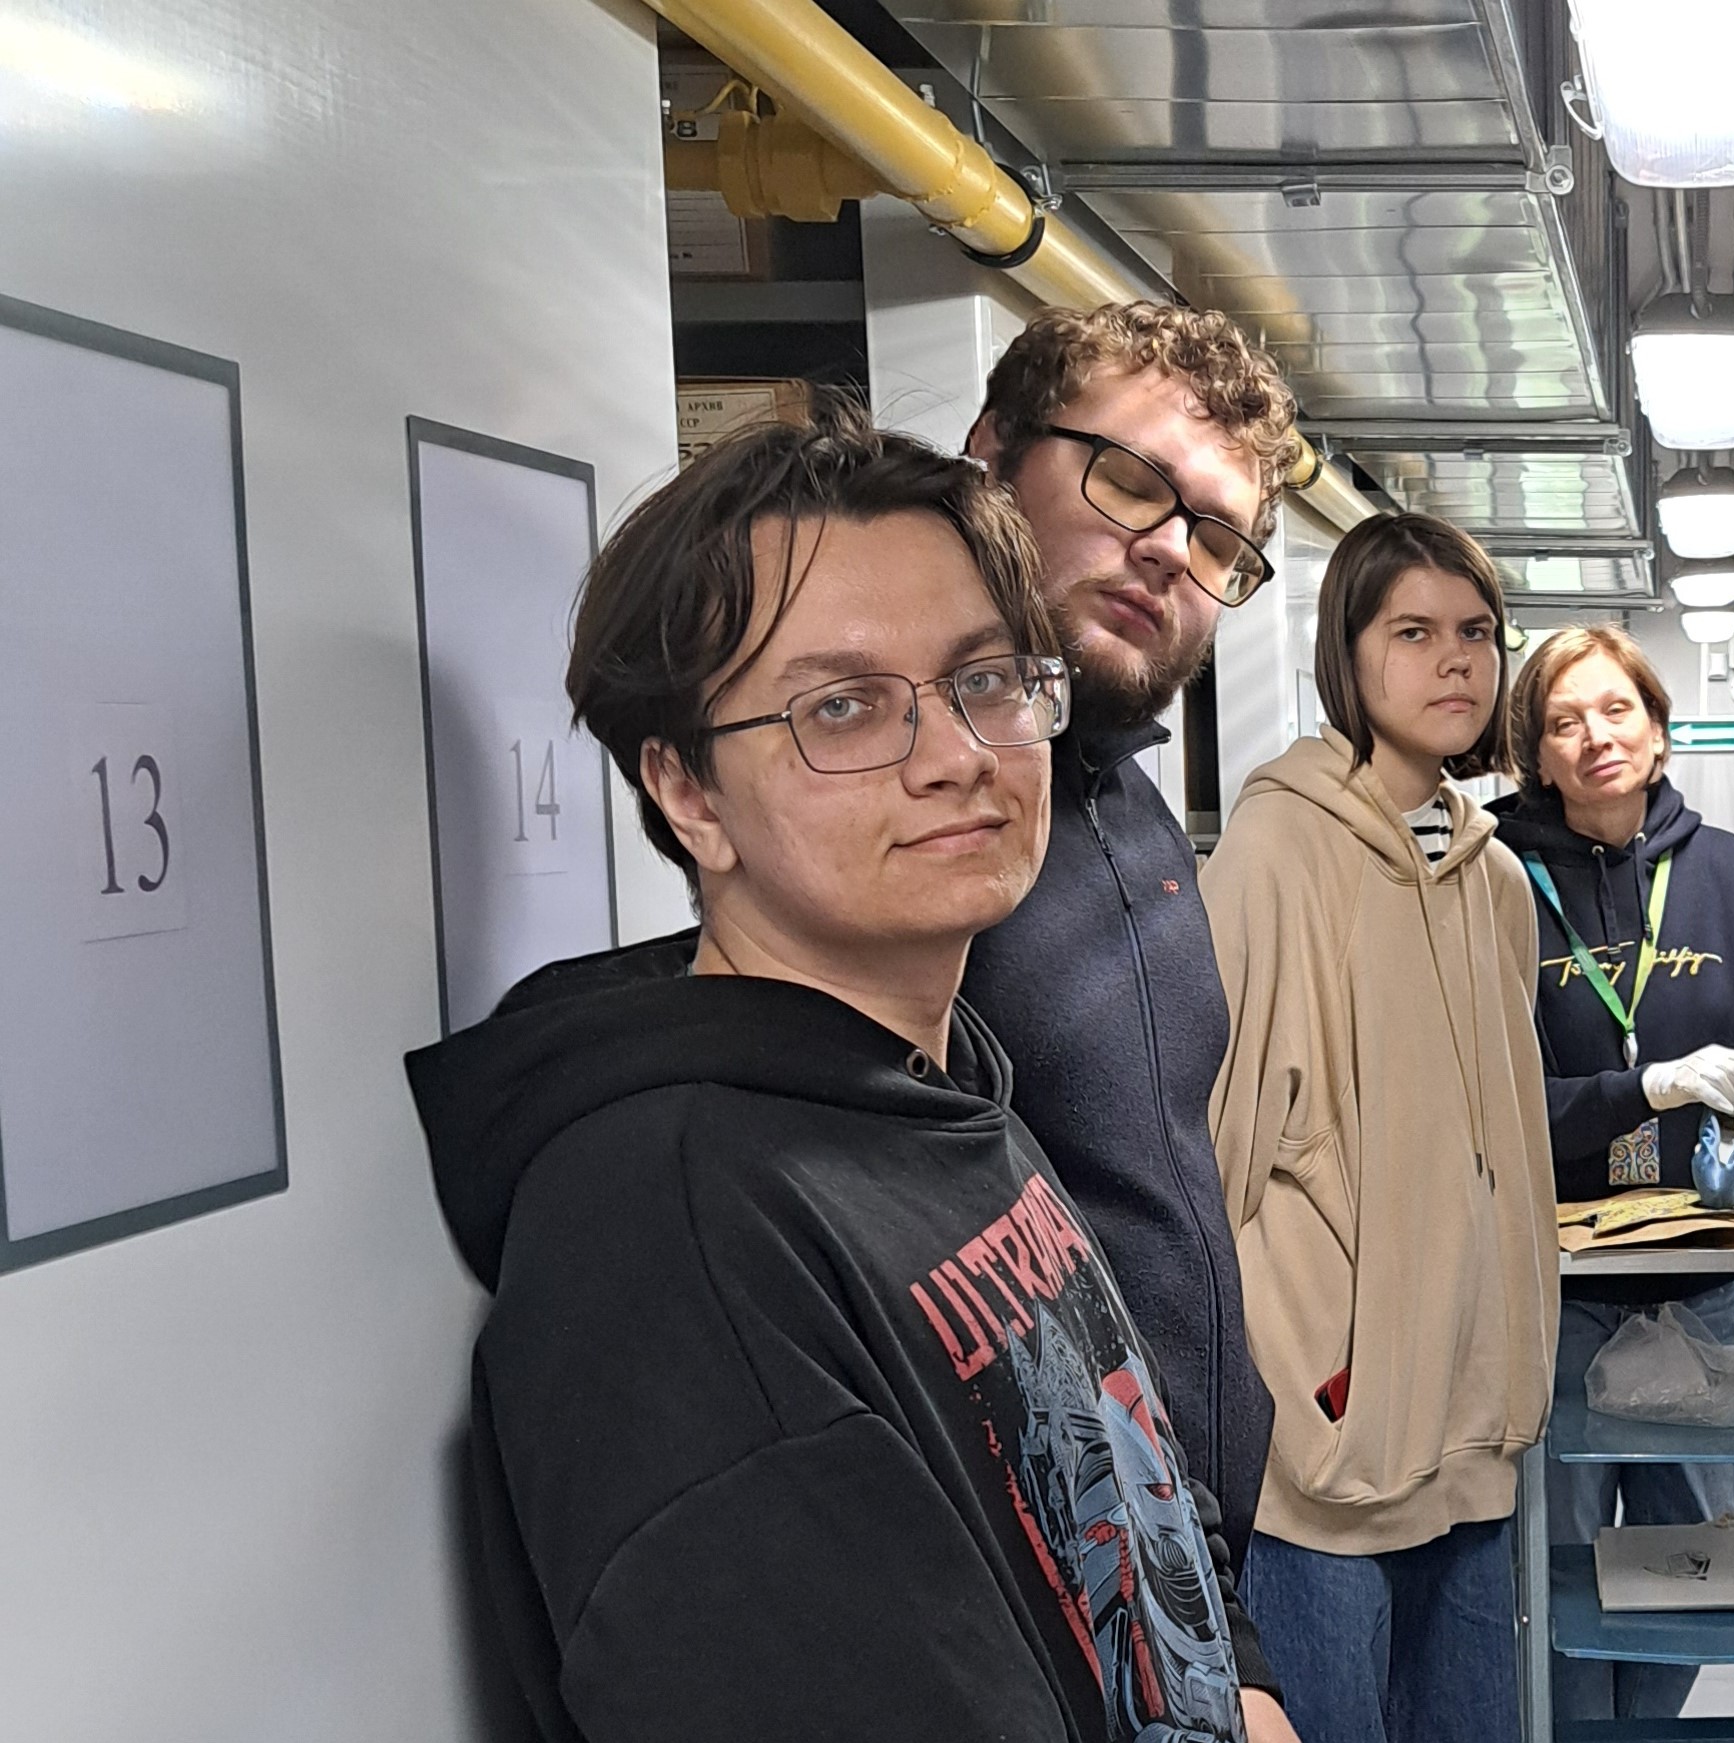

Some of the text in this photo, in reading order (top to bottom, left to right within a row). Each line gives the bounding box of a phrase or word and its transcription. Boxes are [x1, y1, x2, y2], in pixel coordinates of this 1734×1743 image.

[91, 754, 170, 896] 13
[508, 739, 562, 842] 14
[909, 1172, 1092, 1382] ULTRAMA
